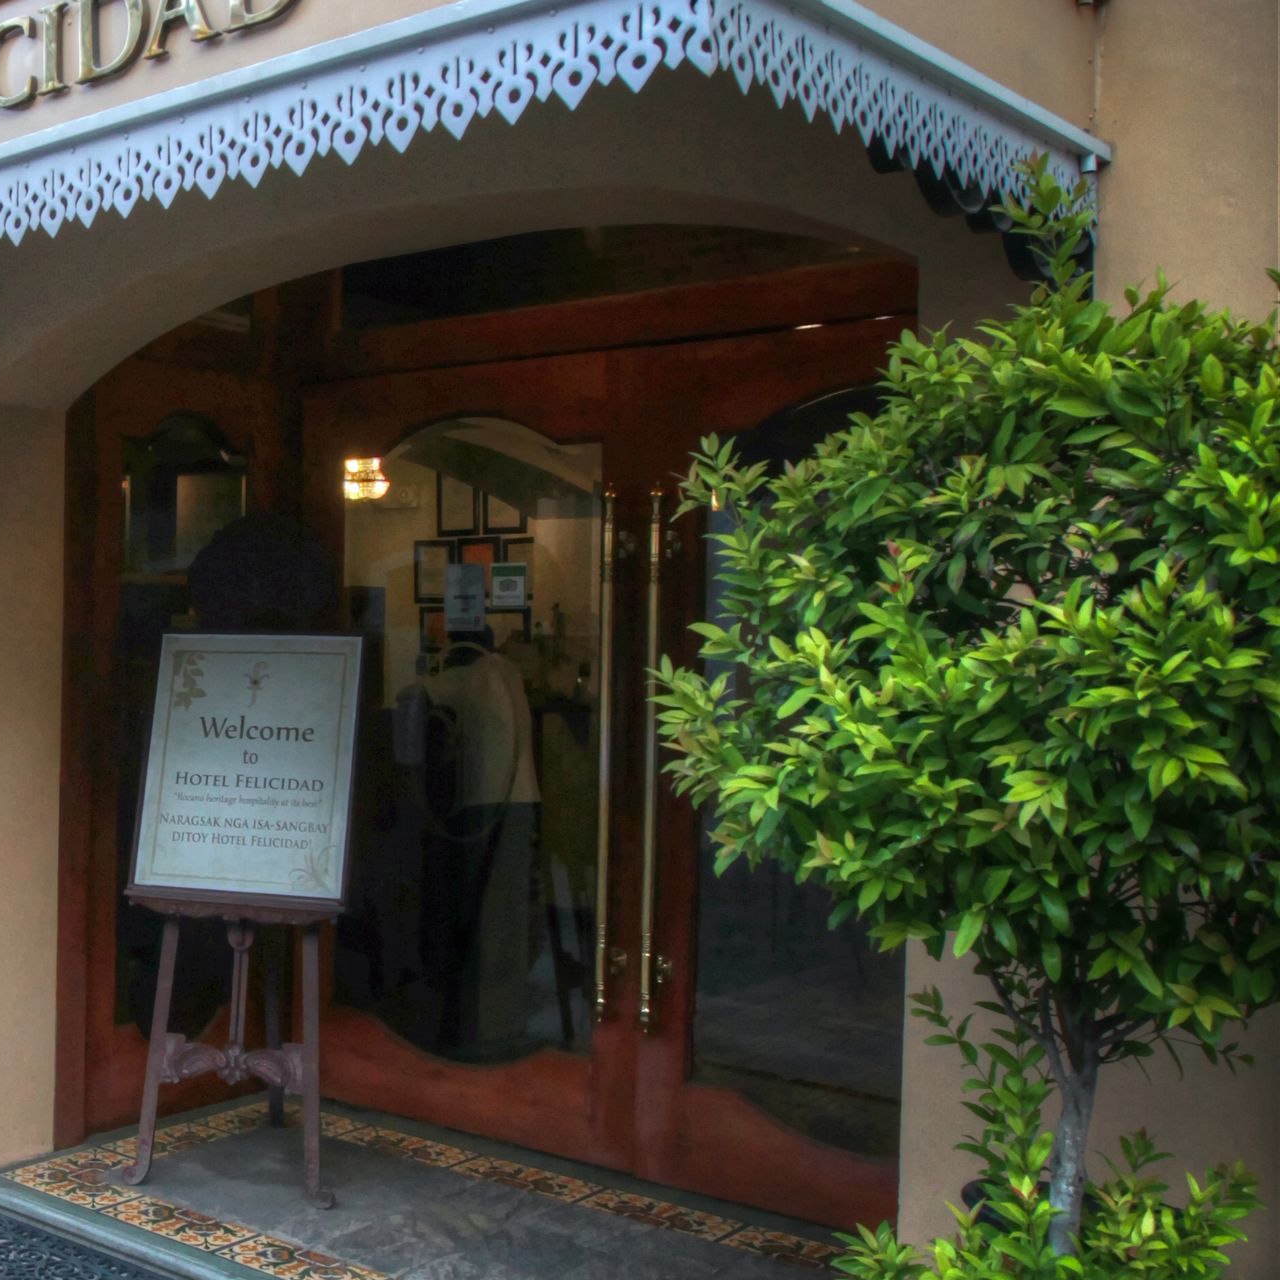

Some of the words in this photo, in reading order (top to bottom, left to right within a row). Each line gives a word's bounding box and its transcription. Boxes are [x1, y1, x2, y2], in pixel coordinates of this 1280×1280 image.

[200, 715, 315, 742] Welcome
[243, 750, 258, 764] to
[175, 771, 229, 787] HOTEL
[235, 774, 324, 792] FELICIDAD
[160, 813, 221, 827] NARAGSAK
[224, 818, 249, 828] NGA
[252, 819, 328, 833] ISA-SANGBAY
[172, 831, 208, 843] DITOY
[211, 833, 247, 846] HOTEL
